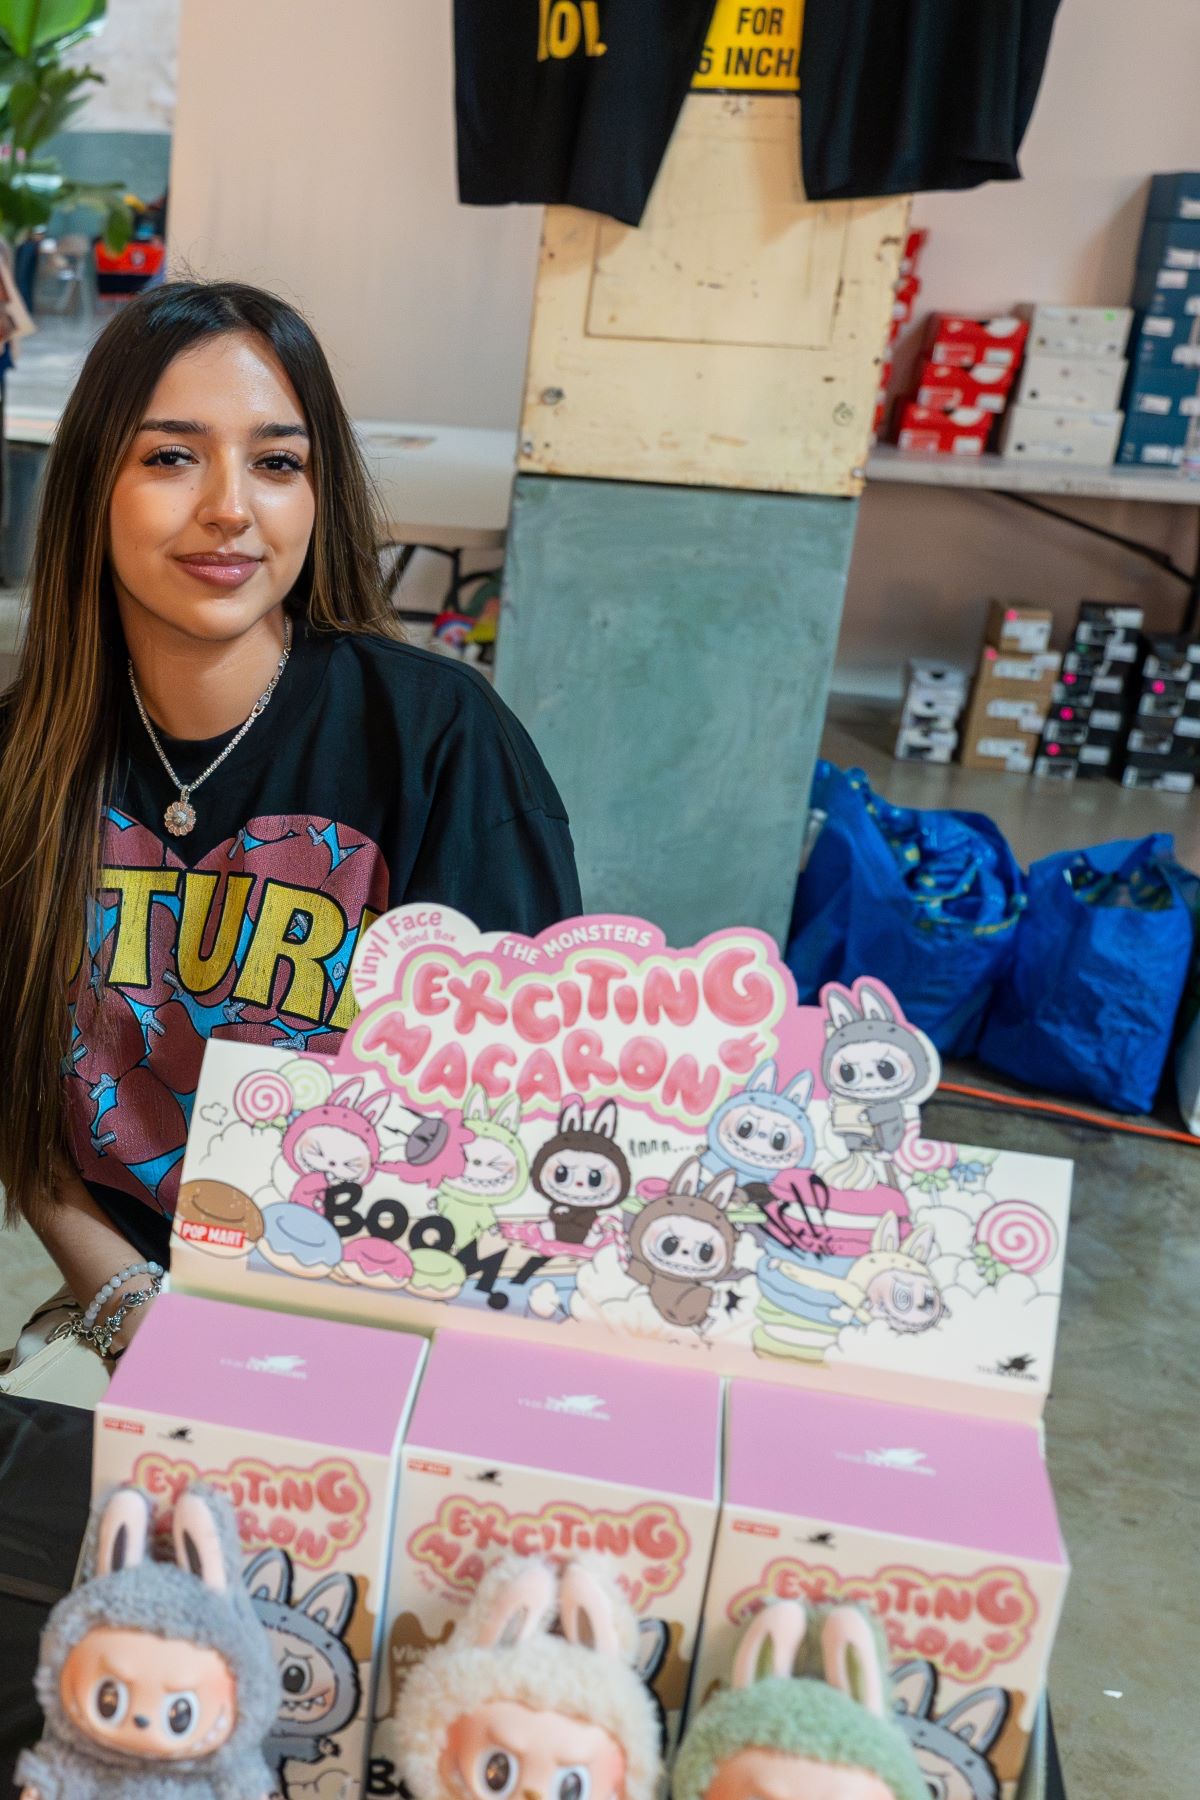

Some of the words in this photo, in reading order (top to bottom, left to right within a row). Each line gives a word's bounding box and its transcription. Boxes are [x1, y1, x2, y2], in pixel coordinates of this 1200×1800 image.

[737, 7, 784, 36] FOR
[70, 865, 382, 1030] TUR
[354, 929, 389, 994] Vinyl
[386, 911, 443, 937] Face
[501, 939, 542, 966] THE
[542, 923, 653, 959] MONSTERS
[413, 948, 774, 1044] EXCITING
[361, 1012, 721, 1116] MACARON
[182, 1223, 207, 1240] POP
[208, 1227, 242, 1246] MART
